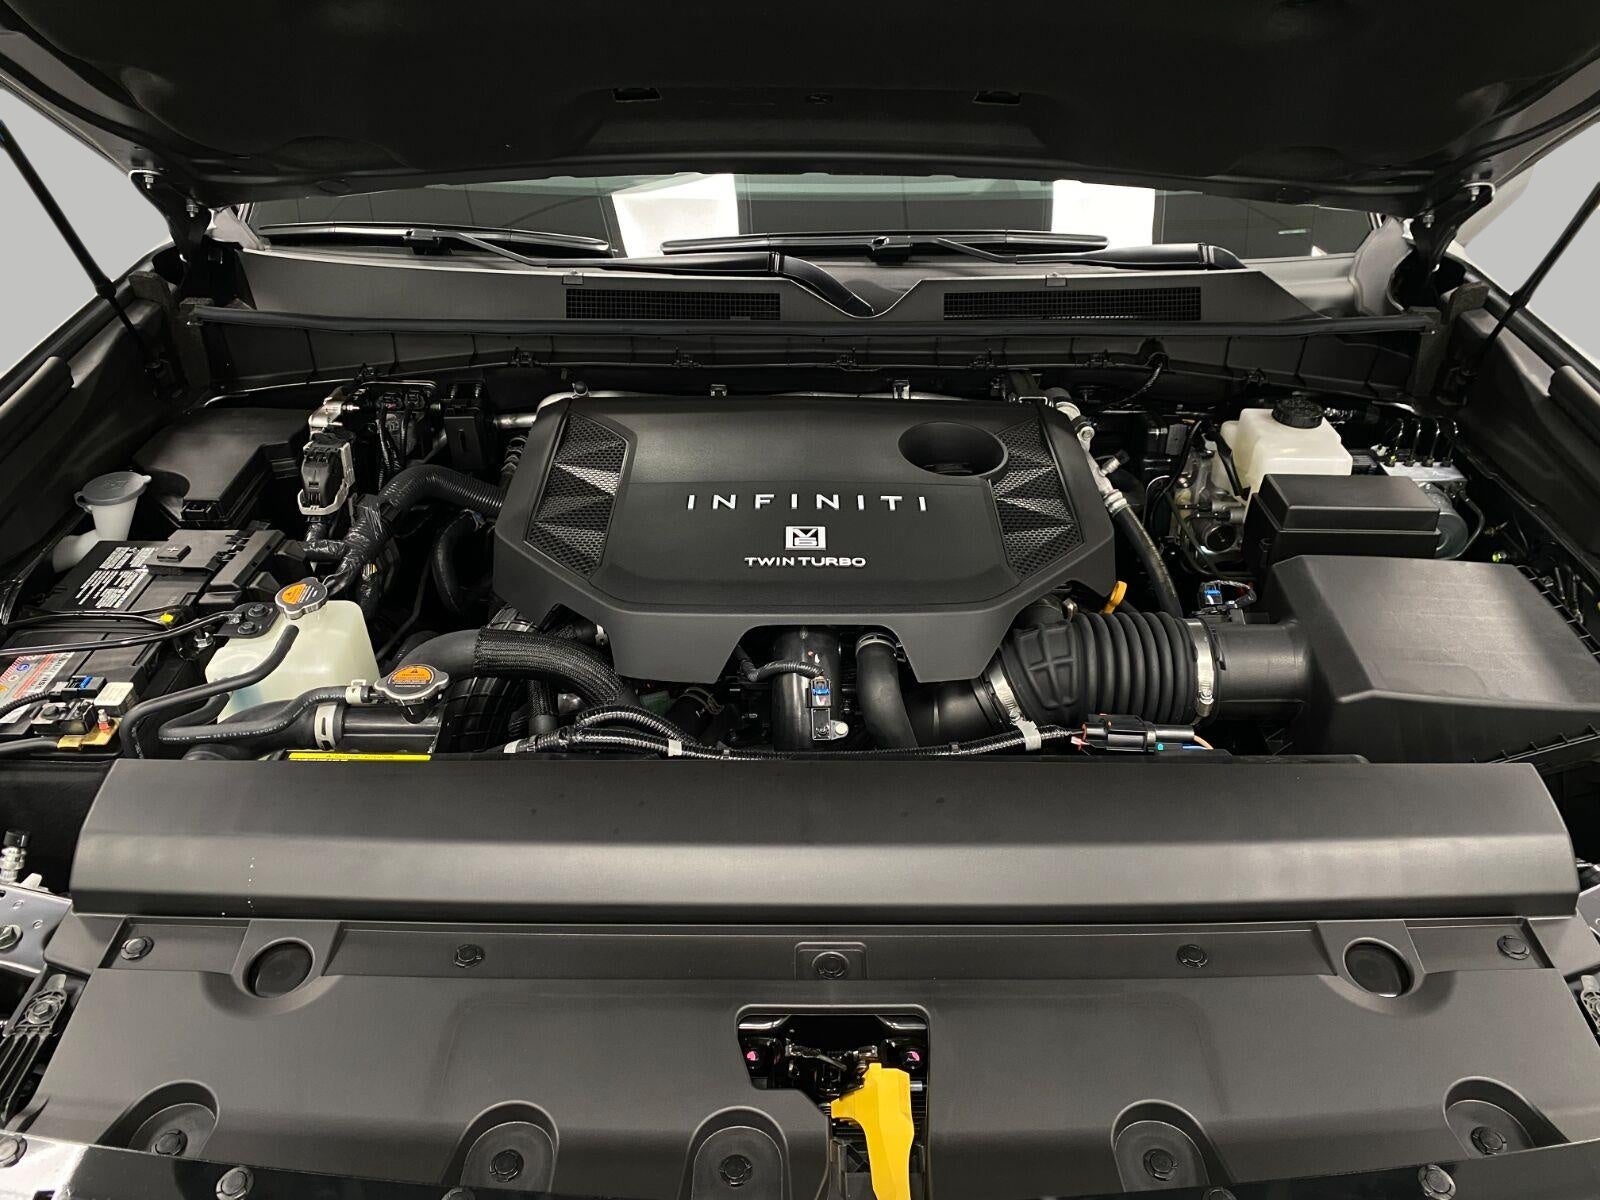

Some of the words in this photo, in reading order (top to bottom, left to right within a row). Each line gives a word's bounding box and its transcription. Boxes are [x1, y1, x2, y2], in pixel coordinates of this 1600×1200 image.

[687, 493, 927, 512] INFINITI
[790, 527, 820, 548] V6
[744, 556, 795, 567] TWIN
[798, 556, 867, 568] TURBO
